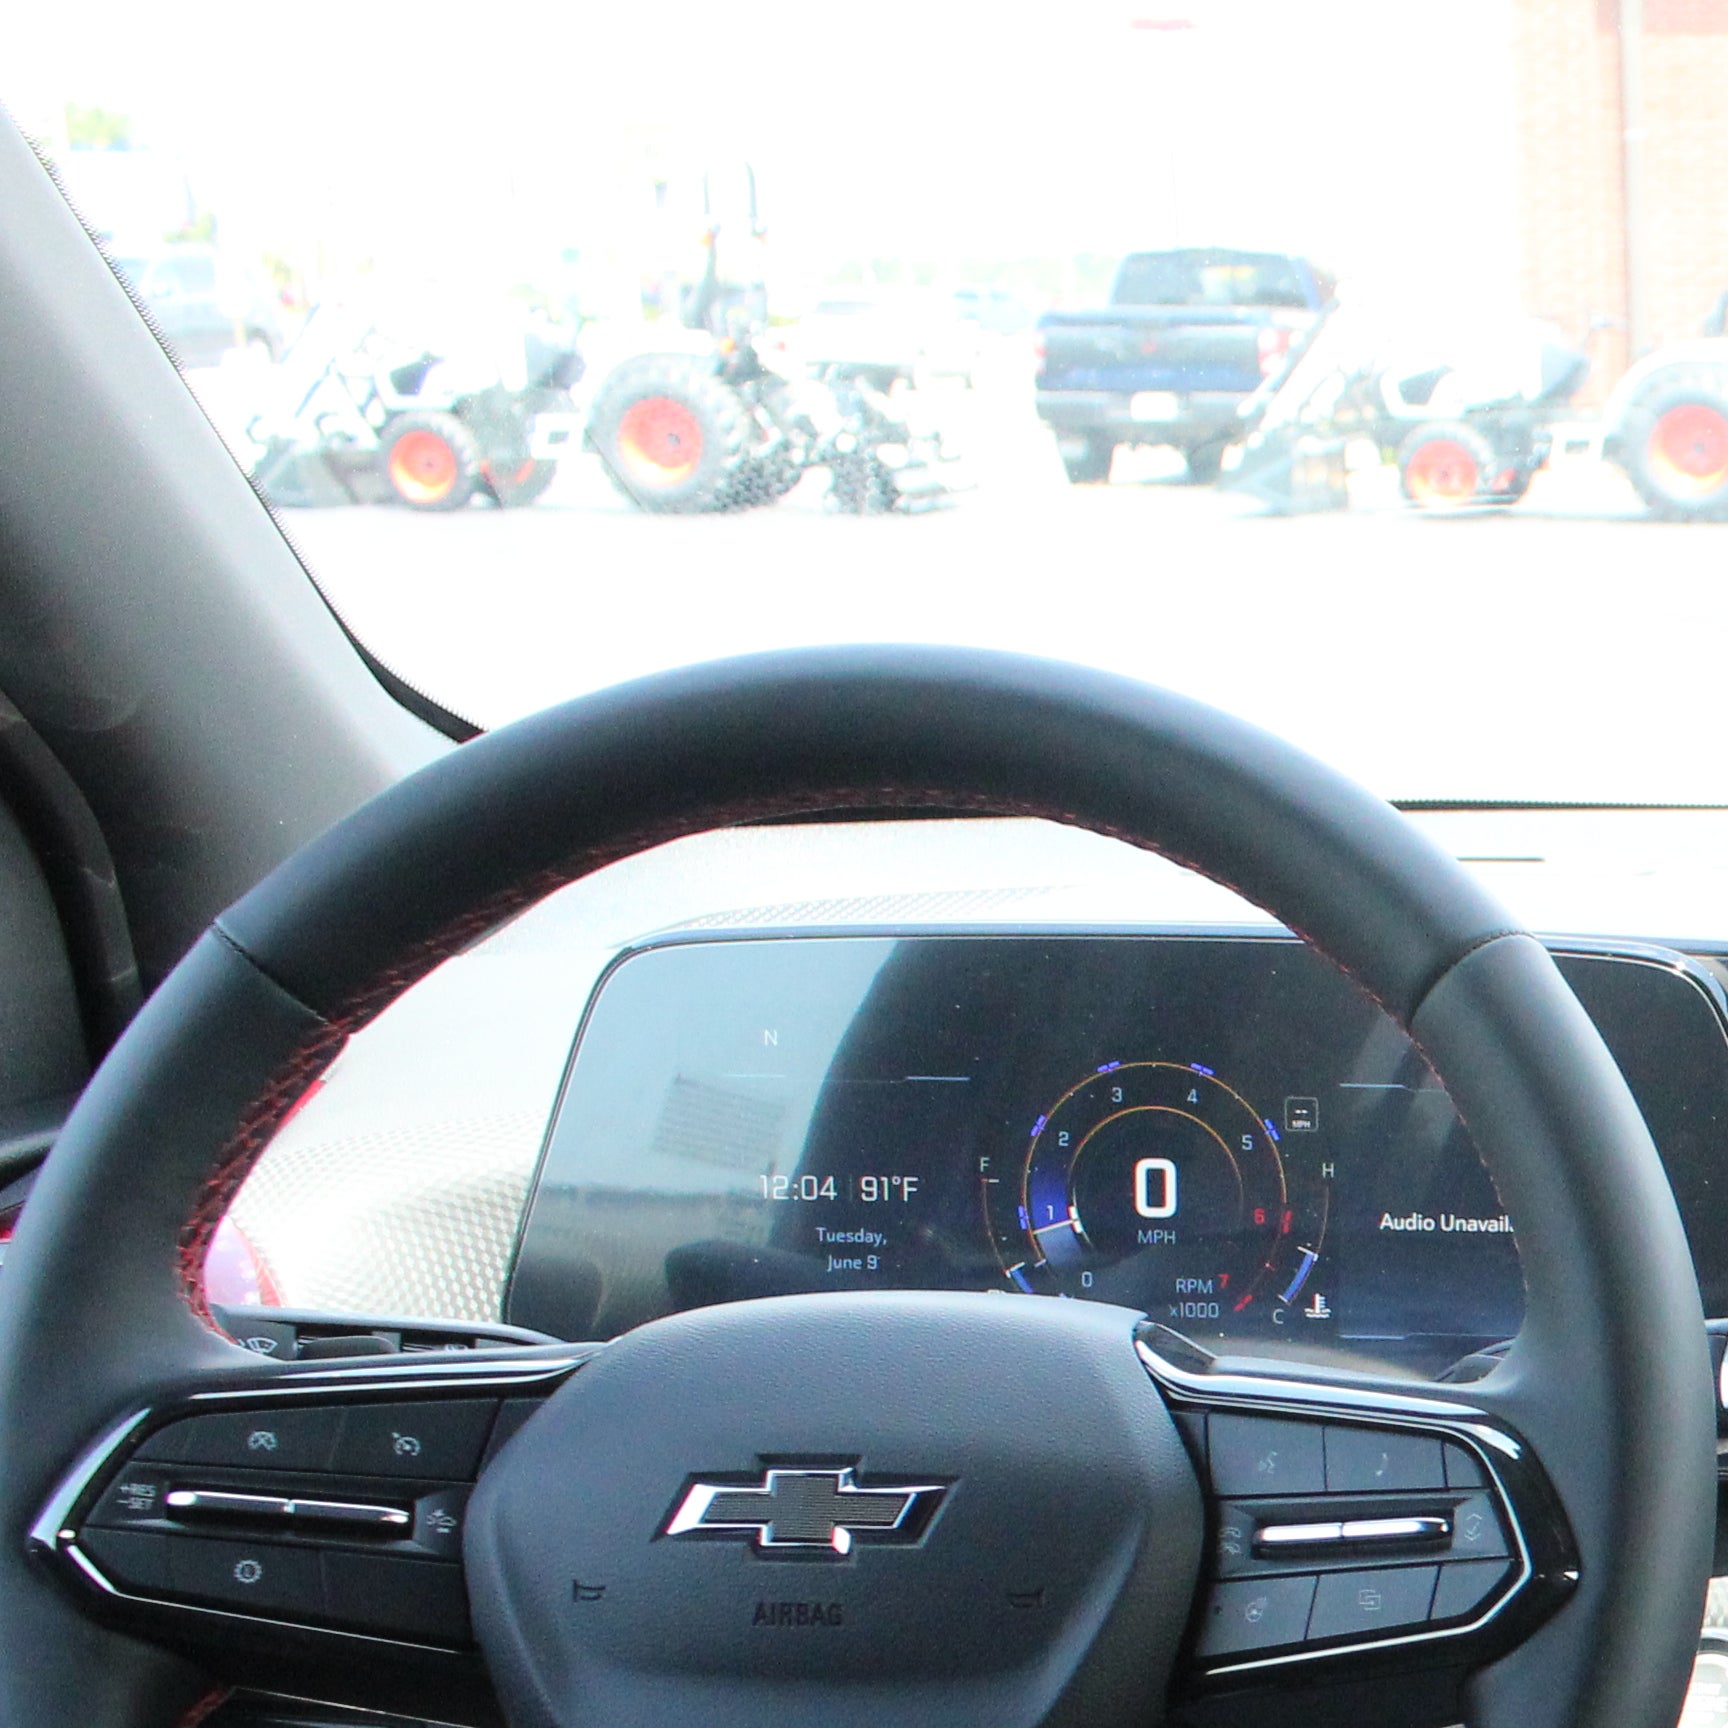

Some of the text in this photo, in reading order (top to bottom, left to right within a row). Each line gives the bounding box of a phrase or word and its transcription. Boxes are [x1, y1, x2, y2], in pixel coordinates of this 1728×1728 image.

[764, 1029, 778, 1046] N
[1112, 1087, 1123, 1103] 3
[1187, 1088, 1198, 1104] 4
[1058, 1131, 1069, 1147] 2
[1242, 1135, 1253, 1151] 5
[980, 1157, 990, 1172] F
[1322, 1163, 1334, 1178] H
[760, 1175, 919, 1202] 12:04 91°F
[1133, 1158, 1179, 1218] 0
[1046, 1204, 1054, 1220] 1
[1253, 1209, 1265, 1225] 6
[1379, 1212, 1514, 1233] Audio Unavail
[815, 1226, 887, 1248] Tuesday,
[1137, 1230, 1176, 1244] MPH
[826, 1255, 862, 1272] June
[1081, 1272, 1093, 1288] 0
[1175, 1279, 1213, 1294] RPM
[1218, 1274, 1230, 1288] 7
[1168, 1303, 1220, 1319] x1000
[1273, 1309, 1284, 1324] C
[751, 1602, 843, 1627] AIRBAG
